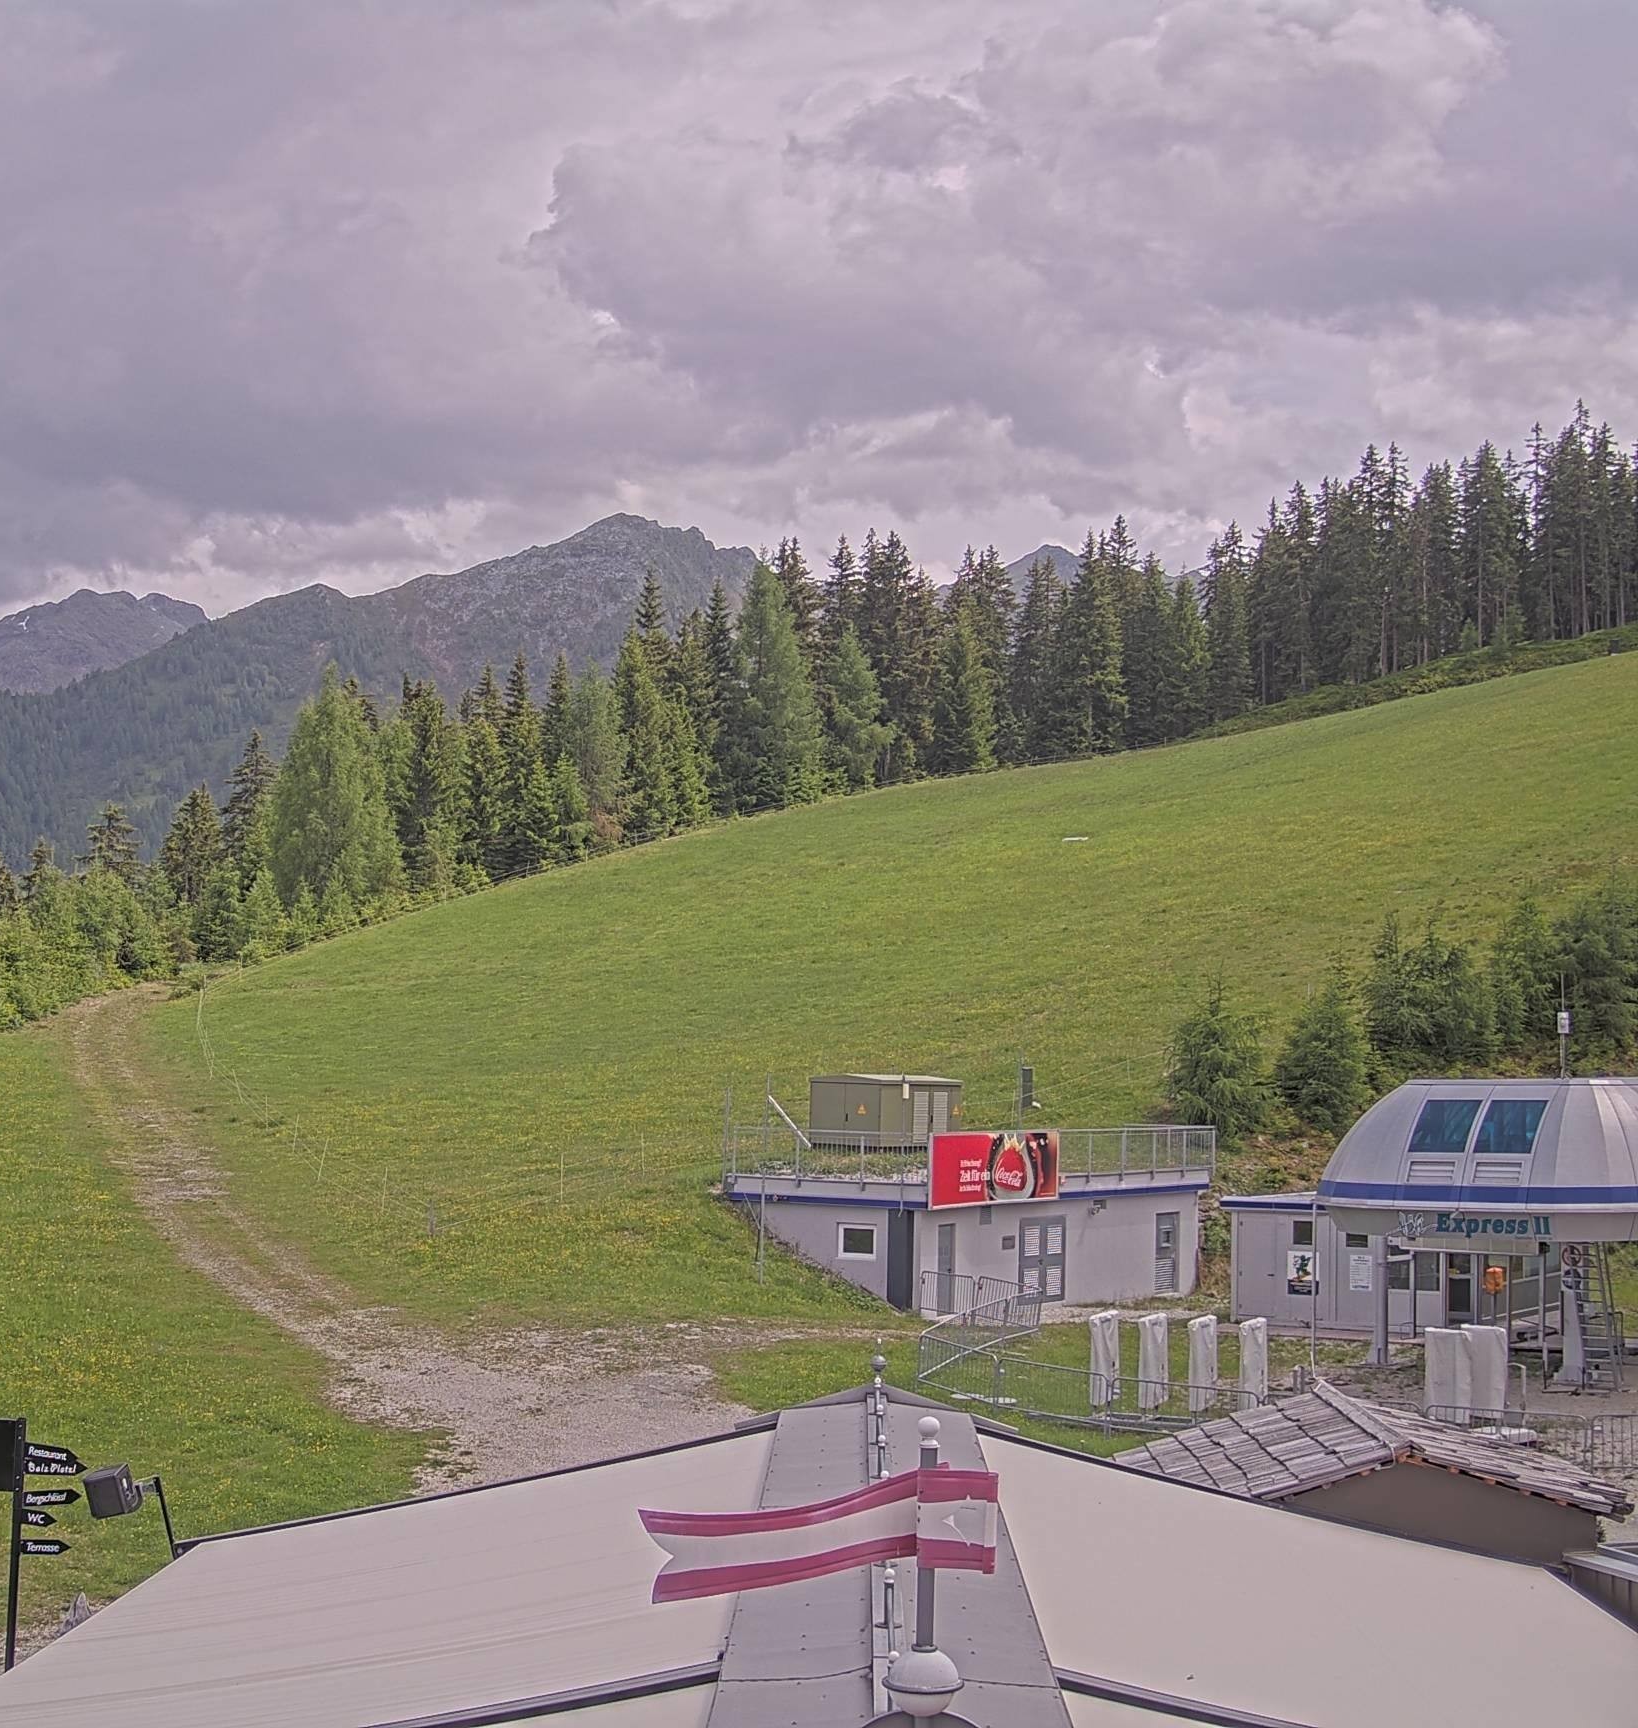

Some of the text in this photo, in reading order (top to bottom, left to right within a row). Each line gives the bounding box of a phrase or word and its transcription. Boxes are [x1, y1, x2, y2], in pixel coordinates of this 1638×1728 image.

[1435, 1213, 1529, 1238] Express
[28, 1445, 67, 1461] Restaurant
[27, 1512, 46, 1524] WC
[26, 1541, 61, 1553] Terrasse
